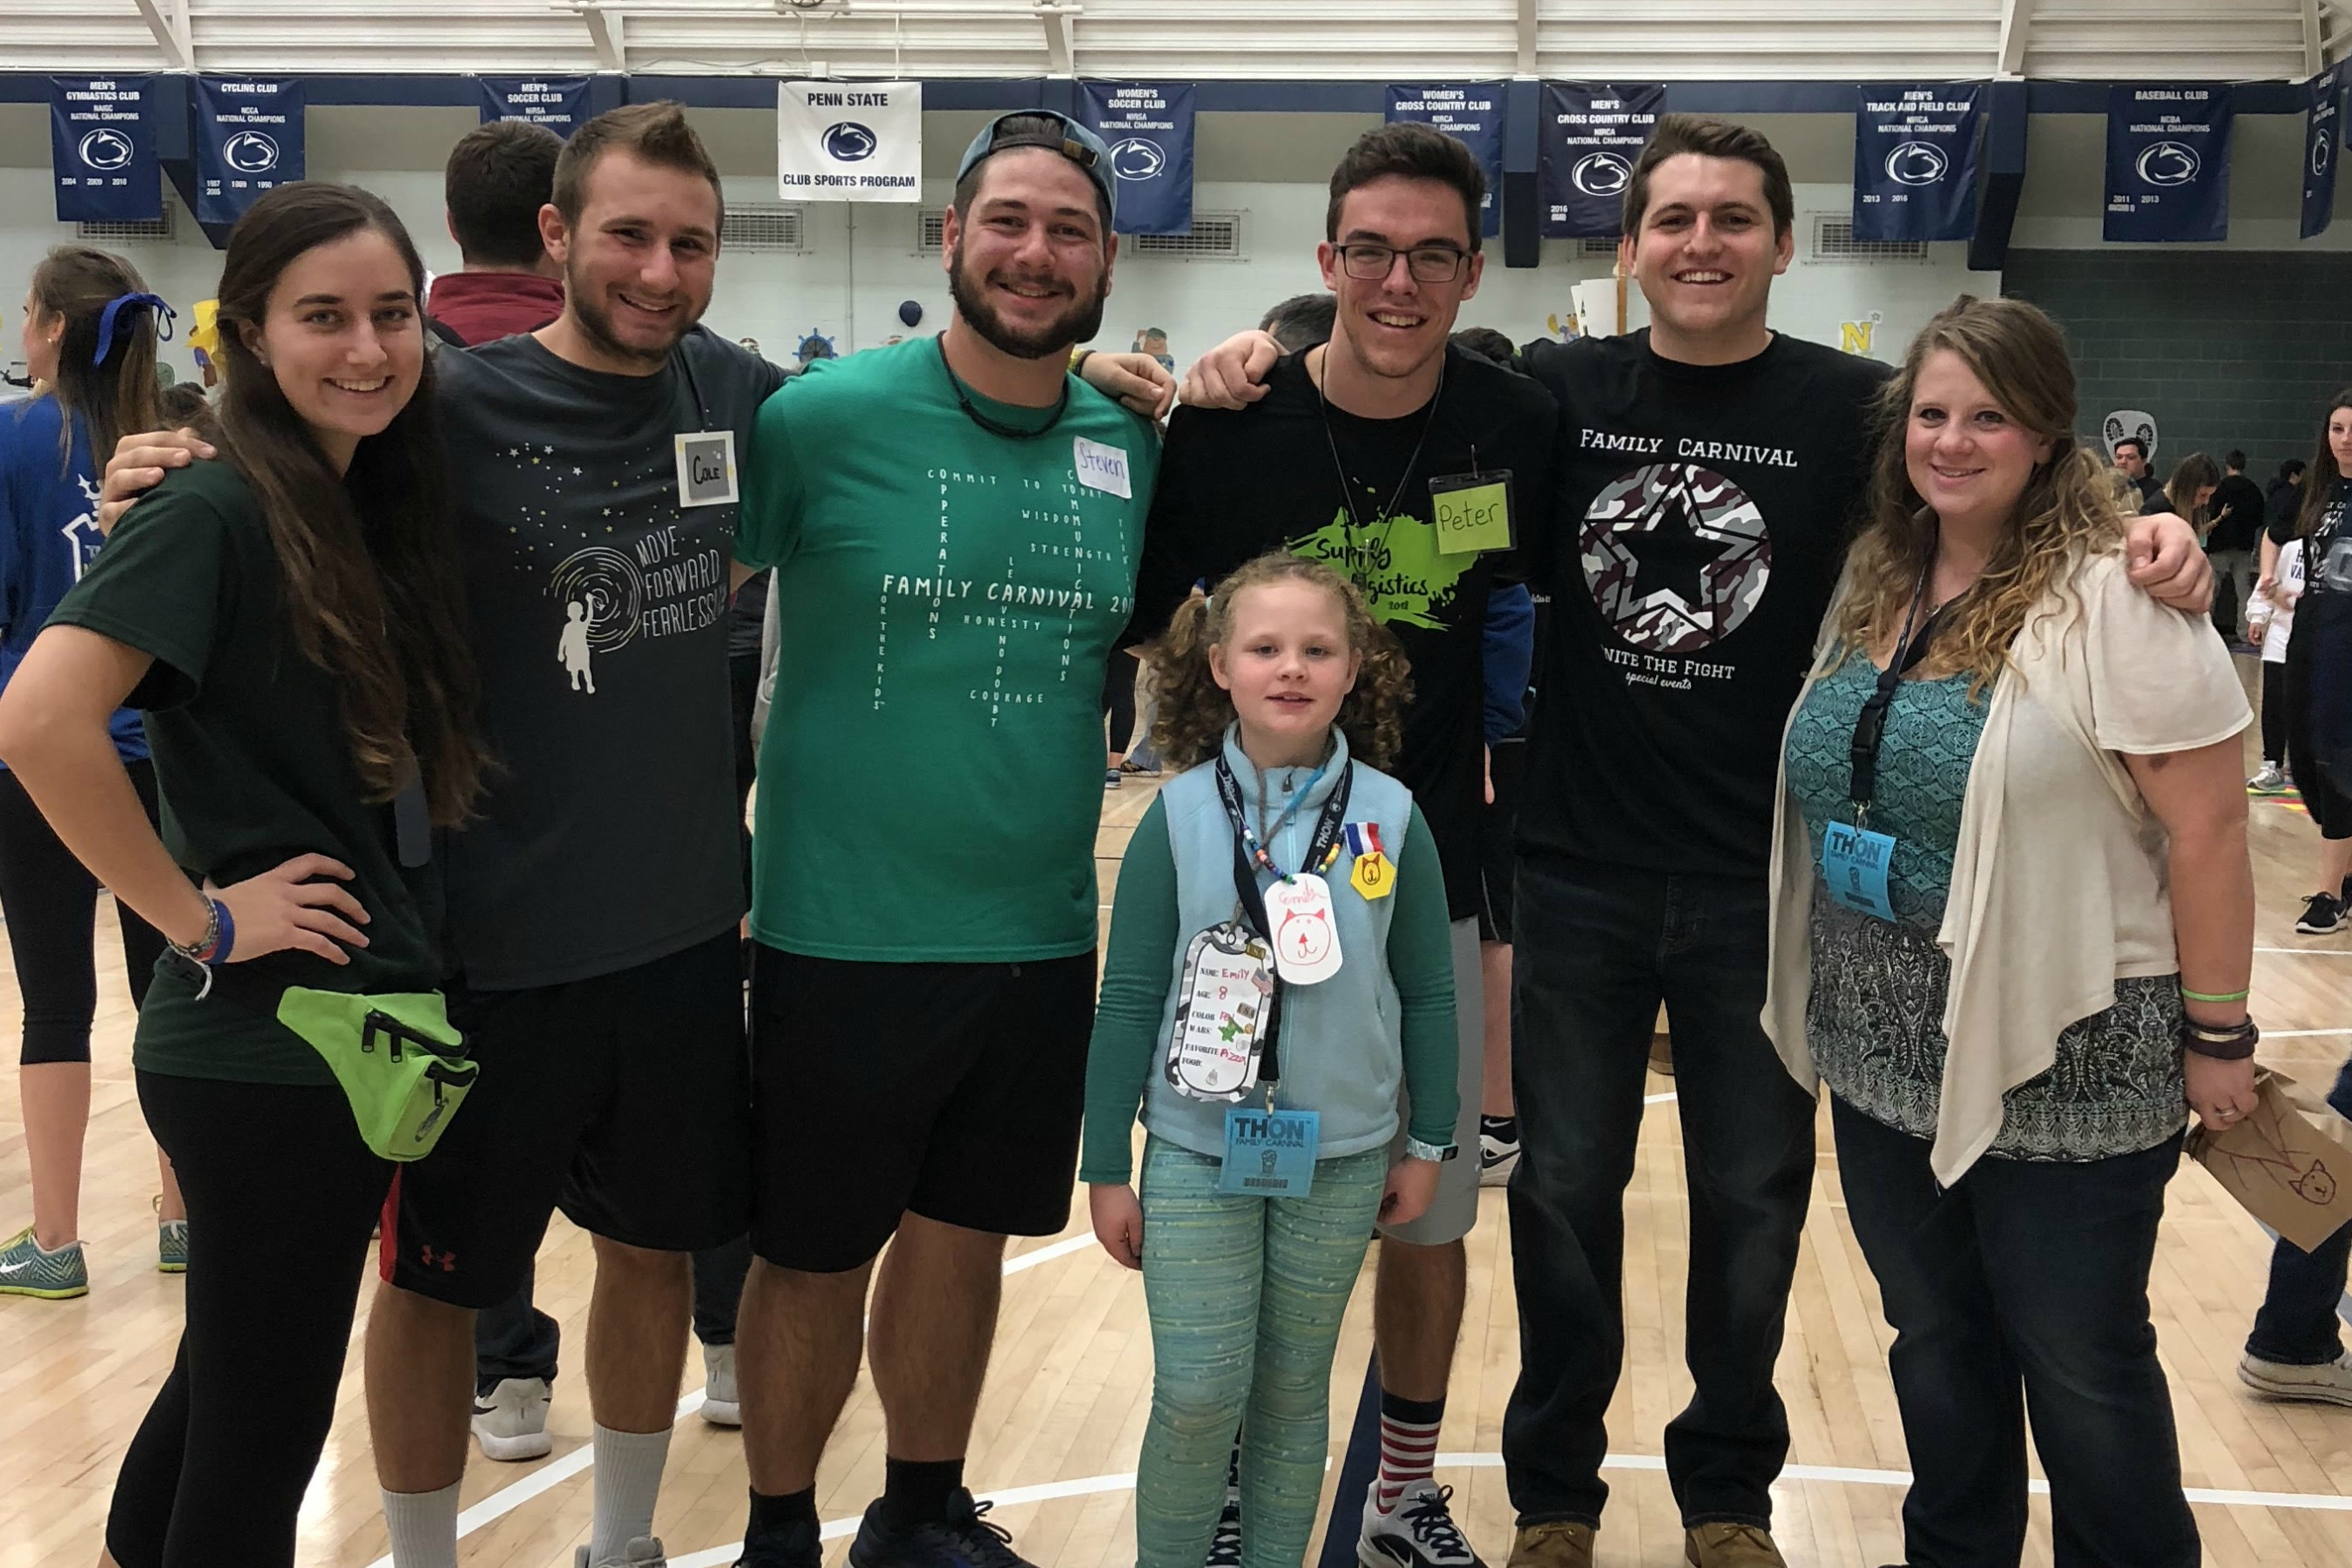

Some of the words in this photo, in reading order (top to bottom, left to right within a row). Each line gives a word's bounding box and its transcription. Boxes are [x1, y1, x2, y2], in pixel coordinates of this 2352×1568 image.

[90, 81, 116, 91] MEN'S
[221, 83, 255, 93] CYCLING
[257, 84, 278, 93] CLUB
[521, 84, 548, 92] MEN'S
[66, 91, 117, 101] GYMNASTICS
[119, 91, 140, 101] CLUB
[507, 93, 539, 103] SOCCER
[541, 93, 563, 103] CLUB
[808, 92, 843, 106] PENN
[847, 93, 889, 106] STATE
[1116, 89, 1159, 98] WOMEN'S
[1422, 90, 1465, 100] WOMEN'S
[1903, 91, 1933, 101] MEN'S
[2135, 91, 2182, 100] BASEBALL
[2184, 91, 2209, 100] CLUB
[1107, 99, 1142, 109] SOCCER
[1144, 99, 1166, 109] CLUB
[1395, 101, 1425, 112] CROSS
[1426, 100, 1467, 112] COUNTRY
[1468, 100, 1491, 111] CLUB
[1591, 100, 1619, 110] MEN'S
[1866, 102, 1896, 112] TRACK
[1897, 102, 1916, 112] AND
[1918, 102, 1944, 112] FIELD
[1946, 102, 1970, 112] CLUB
[533, 114, 571, 123] CHAMPIONS
[1557, 114, 1587, 125] CROSS
[1589, 114, 1630, 125] COUNTRY
[1631, 114, 1655, 125] CLUB
[1099, 120, 1132, 129] NATIONAL
[1133, 121, 1174, 130] CHAMPIONS
[1439, 123, 1481, 132] CHAMPIONS
[1877, 125, 1913, 133] NATIONAL
[1914, 125, 1957, 133] CHAMPIONS
[2166, 125, 2211, 133] CHAMPIONS
[1566, 136, 1601, 145] NATIONAL
[1602, 136, 1645, 145] CHAMPIONS
[783, 173, 812, 186] CLUB
[814, 174, 857, 186] SPORTS
[860, 175, 916, 187] PROGRAM
[1862, 194, 1881, 203] 2013
[2112, 194, 2130, 203] 2011
[1550, 205, 1568, 213] 2016
[1579, 429, 1664, 454] FAMILY
[1677, 437, 1799, 468] CARNIVAL
[1079, 442, 1125, 480] Steven
[928, 468, 997, 485] COMMIT
[1023, 479, 1041, 490] TO
[1022, 509, 1082, 527] WISDOM
[1438, 500, 1500, 532] Peter
[635, 525, 680, 568] MOVE
[1030, 543, 1112, 562] STRENGTH
[1315, 537, 1392, 568] Supply
[645, 549, 720, 601] FORWARD
[883, 573, 973, 598] FAMILY
[987, 583, 1095, 611] CARNIVAL
[963, 614, 1042, 632] HONESTY
[1601, 645, 1639, 667] NITE
[1644, 655, 1678, 674] THE
[1683, 659, 1735, 679] FIGHT
[1625, 672, 1659, 686] special
[1659, 678, 1693, 690] events
[970, 689, 1044, 705] COURAGE
[1315, 815, 1335, 849] THON
[1832, 830, 1882, 862] THON
[1219, 985, 1228, 1000] 8
[1191, 1010, 1215, 1021] COLOR
[1184, 1043, 1219, 1056] FAVORITE
[1233, 1117, 1305, 1140] THON
